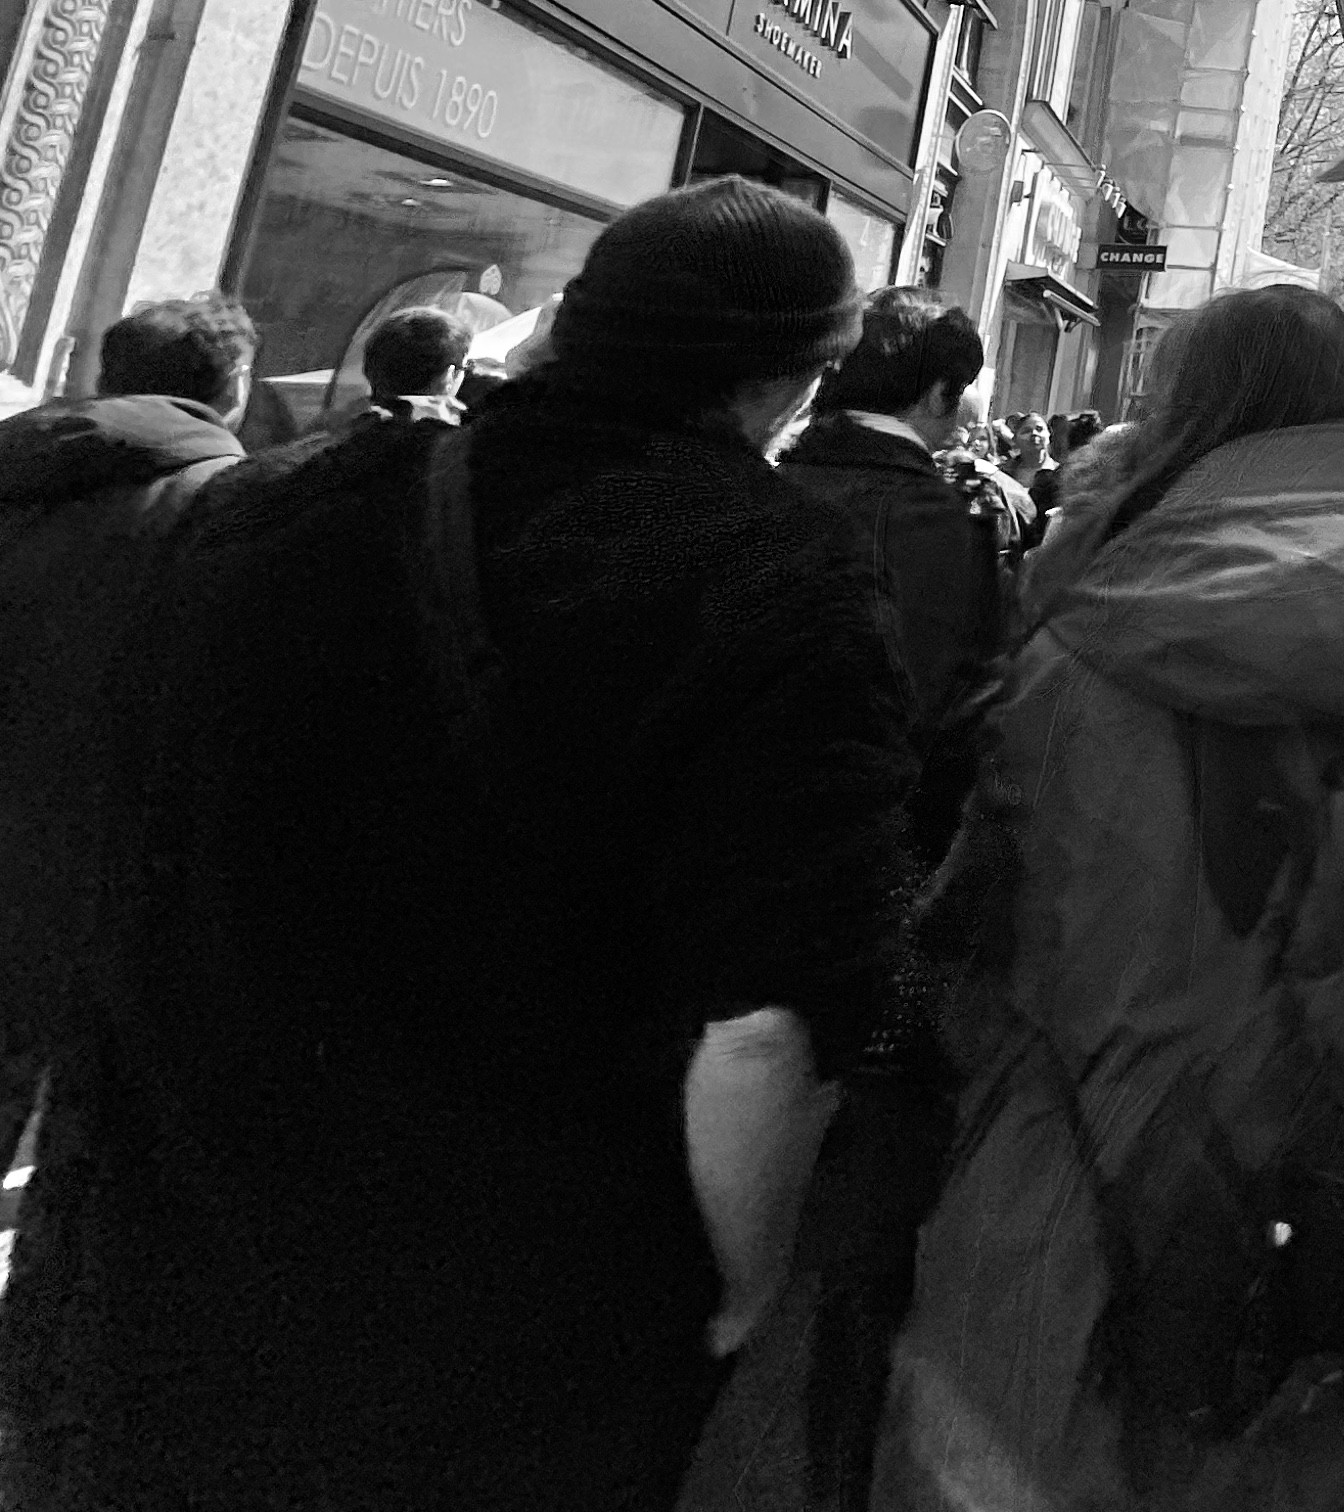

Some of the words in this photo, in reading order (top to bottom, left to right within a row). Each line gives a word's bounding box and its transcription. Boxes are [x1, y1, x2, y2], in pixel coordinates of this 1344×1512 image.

[301, 11, 425, 109] DEPUIS
[432, 68, 498, 138] 1890
[755, 12, 823, 79] SHOEMAKER
[1100, 252, 1164, 263] CHANGE
